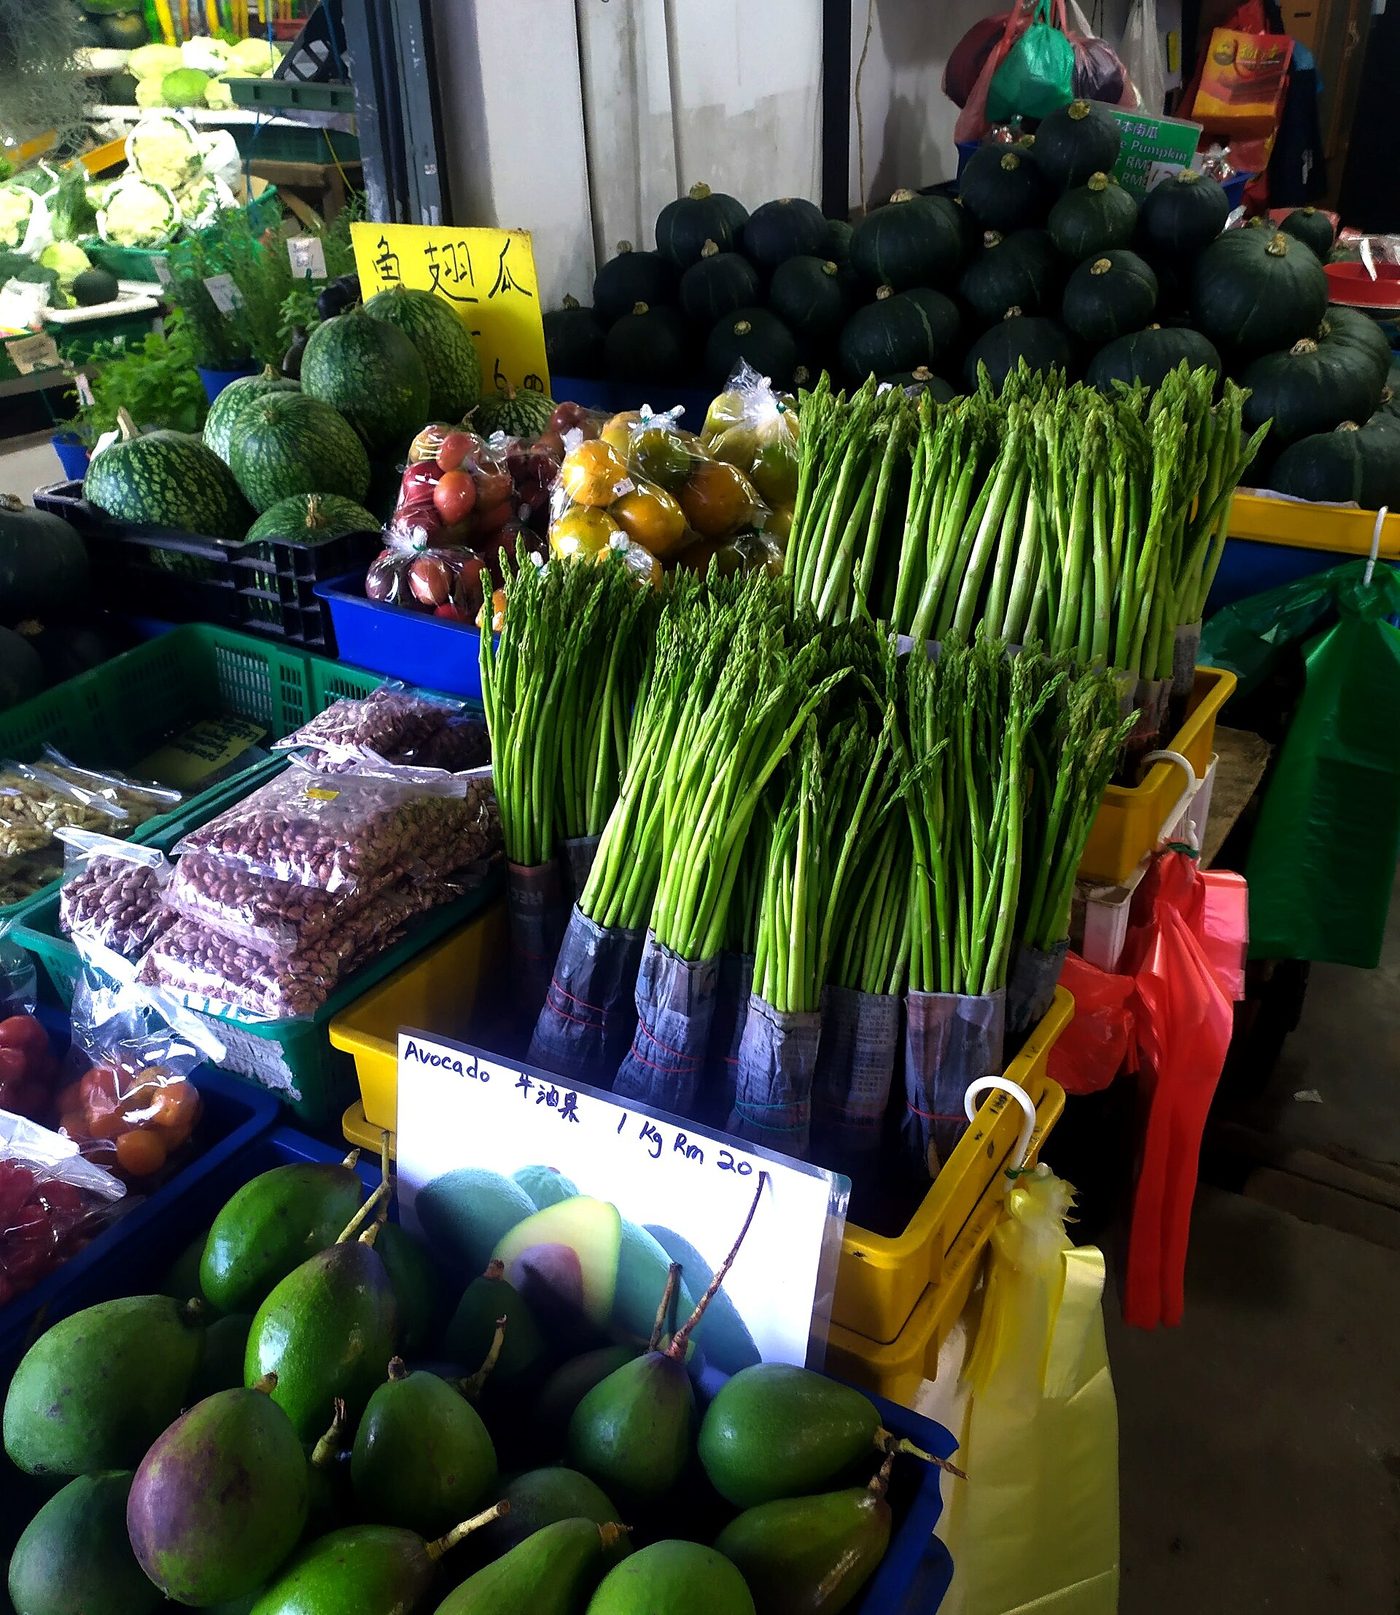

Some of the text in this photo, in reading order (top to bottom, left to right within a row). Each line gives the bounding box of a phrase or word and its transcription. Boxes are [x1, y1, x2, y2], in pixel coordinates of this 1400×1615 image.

[1116, 119, 1158, 139] 本南瓜
[1131, 140, 1187, 161] Pumpkin
[404, 1041, 490, 1083] Avocado
[514, 1073, 580, 1123] 牛油果
[617, 1112, 627, 1134] 1
[716, 1150, 753, 1176] 20
